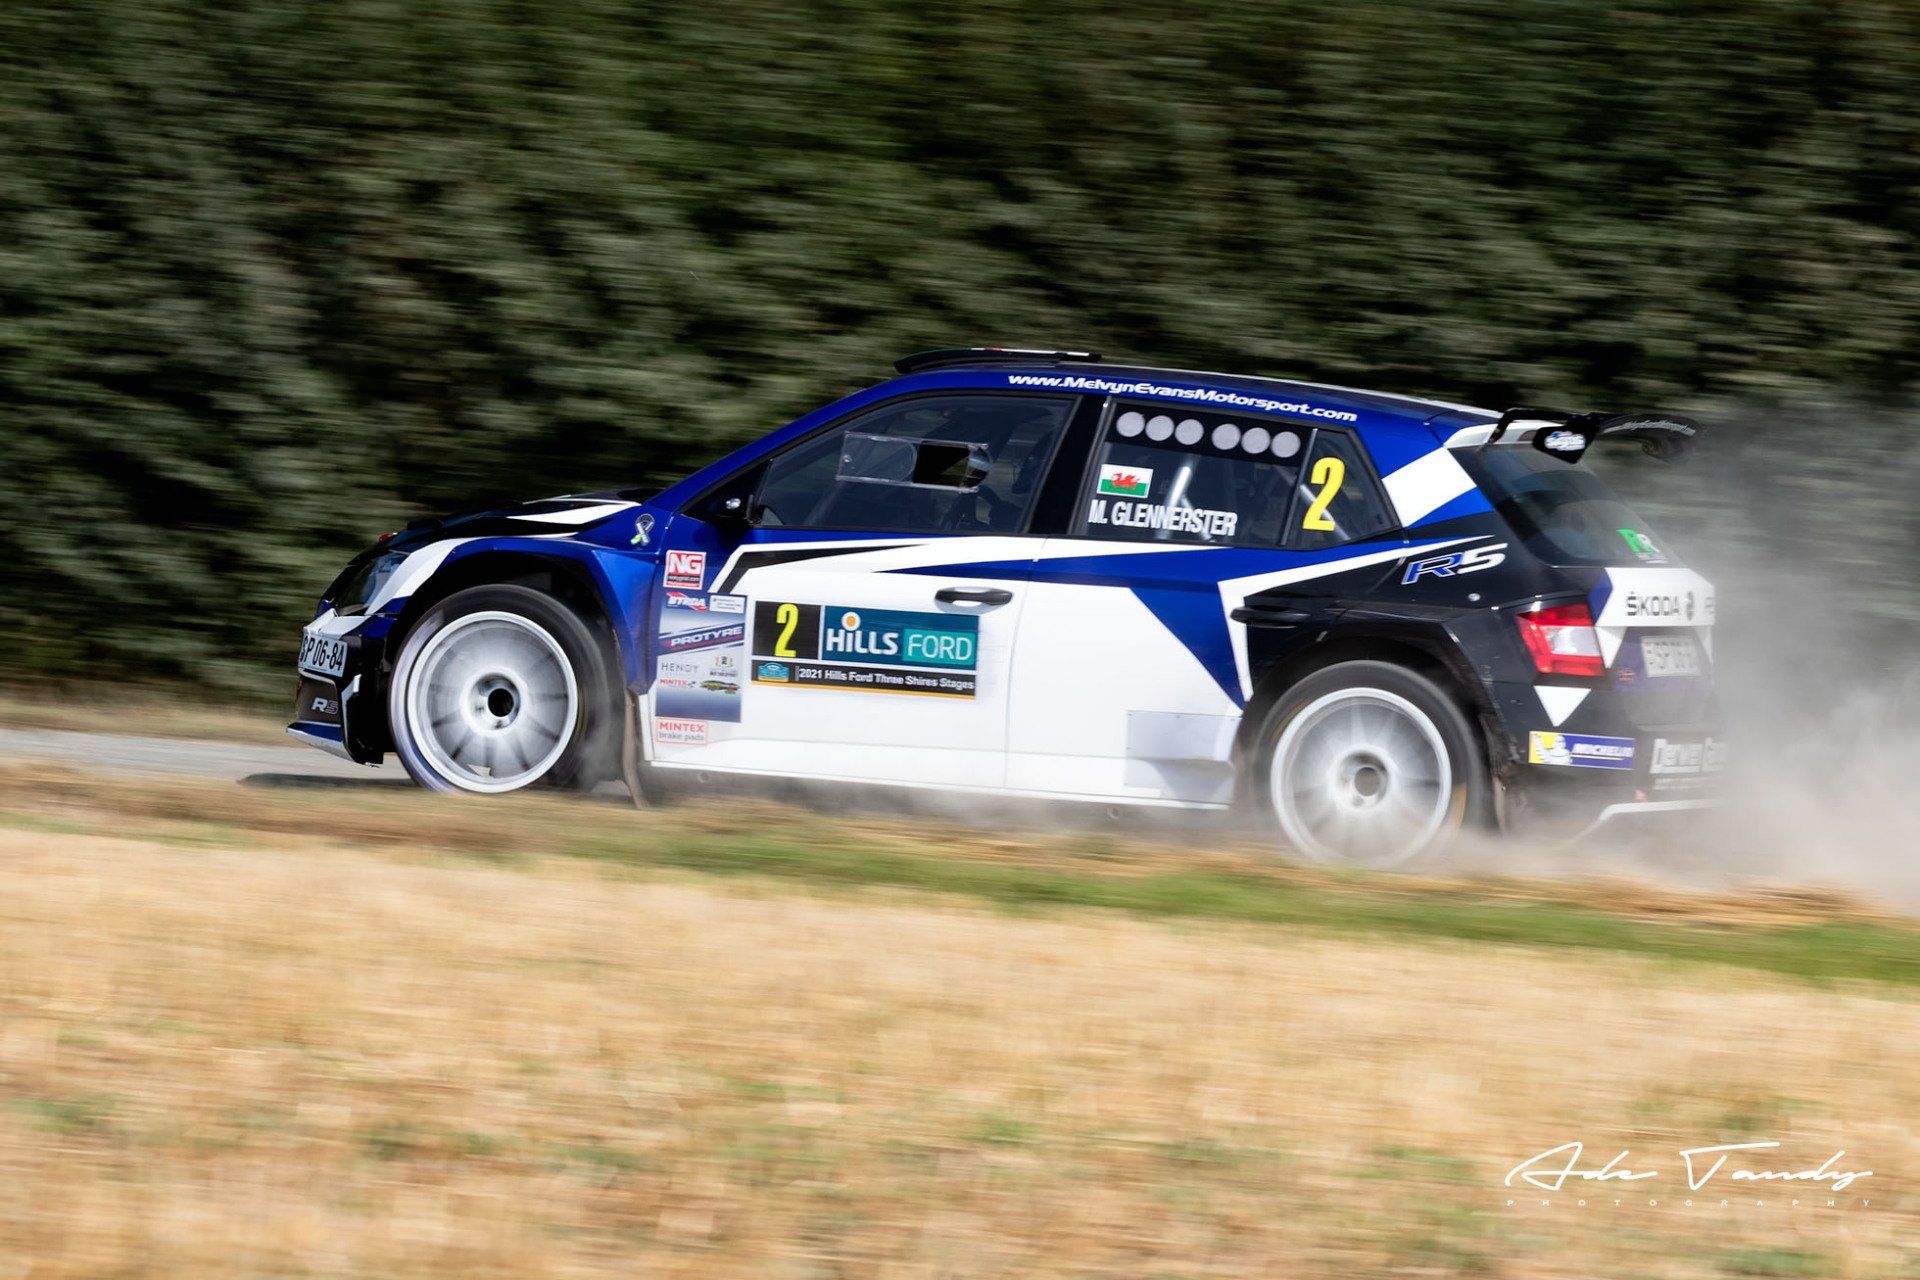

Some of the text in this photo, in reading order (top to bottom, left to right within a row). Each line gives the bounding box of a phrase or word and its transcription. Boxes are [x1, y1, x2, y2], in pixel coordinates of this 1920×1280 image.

[1008, 375, 1358, 422] www.MelvynEvansMotorsport.com
[1302, 457, 1346, 531] 2
[1088, 499, 1238, 536] M. GLENNERSTER
[669, 553, 703, 575] NG
[1401, 543, 1508, 585] R5
[671, 626, 744, 649] PROTYRE
[774, 603, 799, 658] 2
[907, 634, 973, 661] FORD
[799, 667, 975, 691] 2021 Hills Ford Three Shires Stages
[659, 731, 704, 743] brake pads
[660, 721, 704, 732] MINTEX
